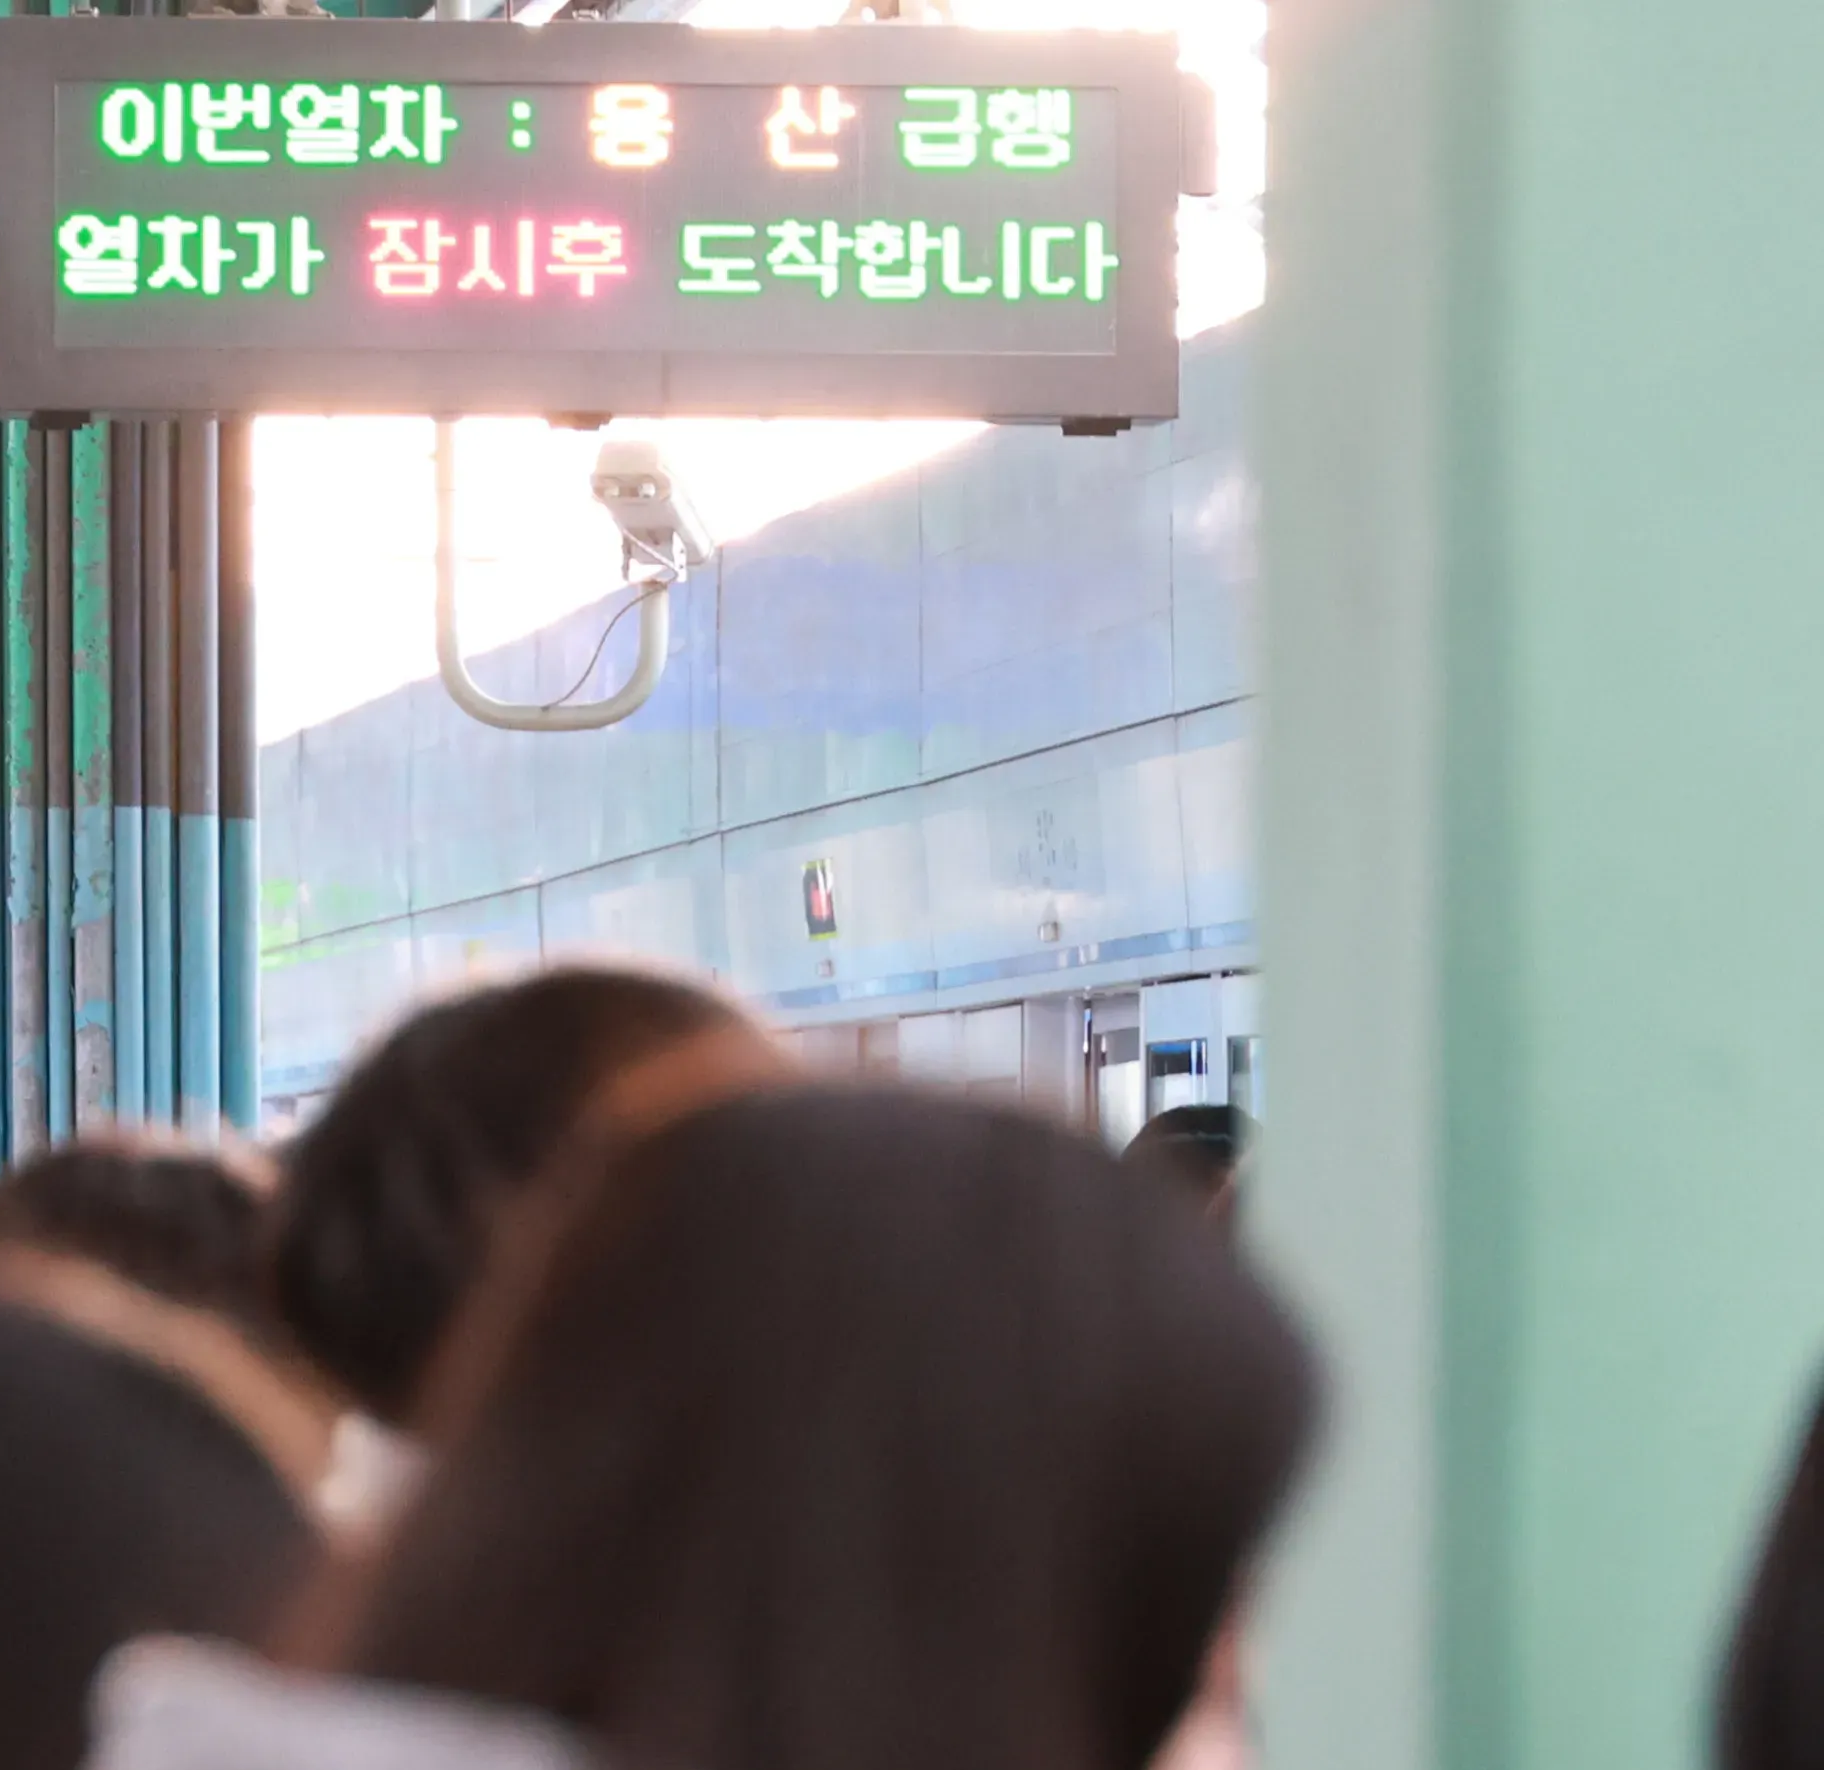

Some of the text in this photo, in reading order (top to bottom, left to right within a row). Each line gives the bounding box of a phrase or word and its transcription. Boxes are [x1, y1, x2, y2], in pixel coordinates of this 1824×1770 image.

[99, 81, 458, 166] 이번열차
[765, 85, 856, 169] 산
[898, 86, 1073, 169] 급행
[56, 213, 1120, 302] 열차가 잠시후 도착합니다
